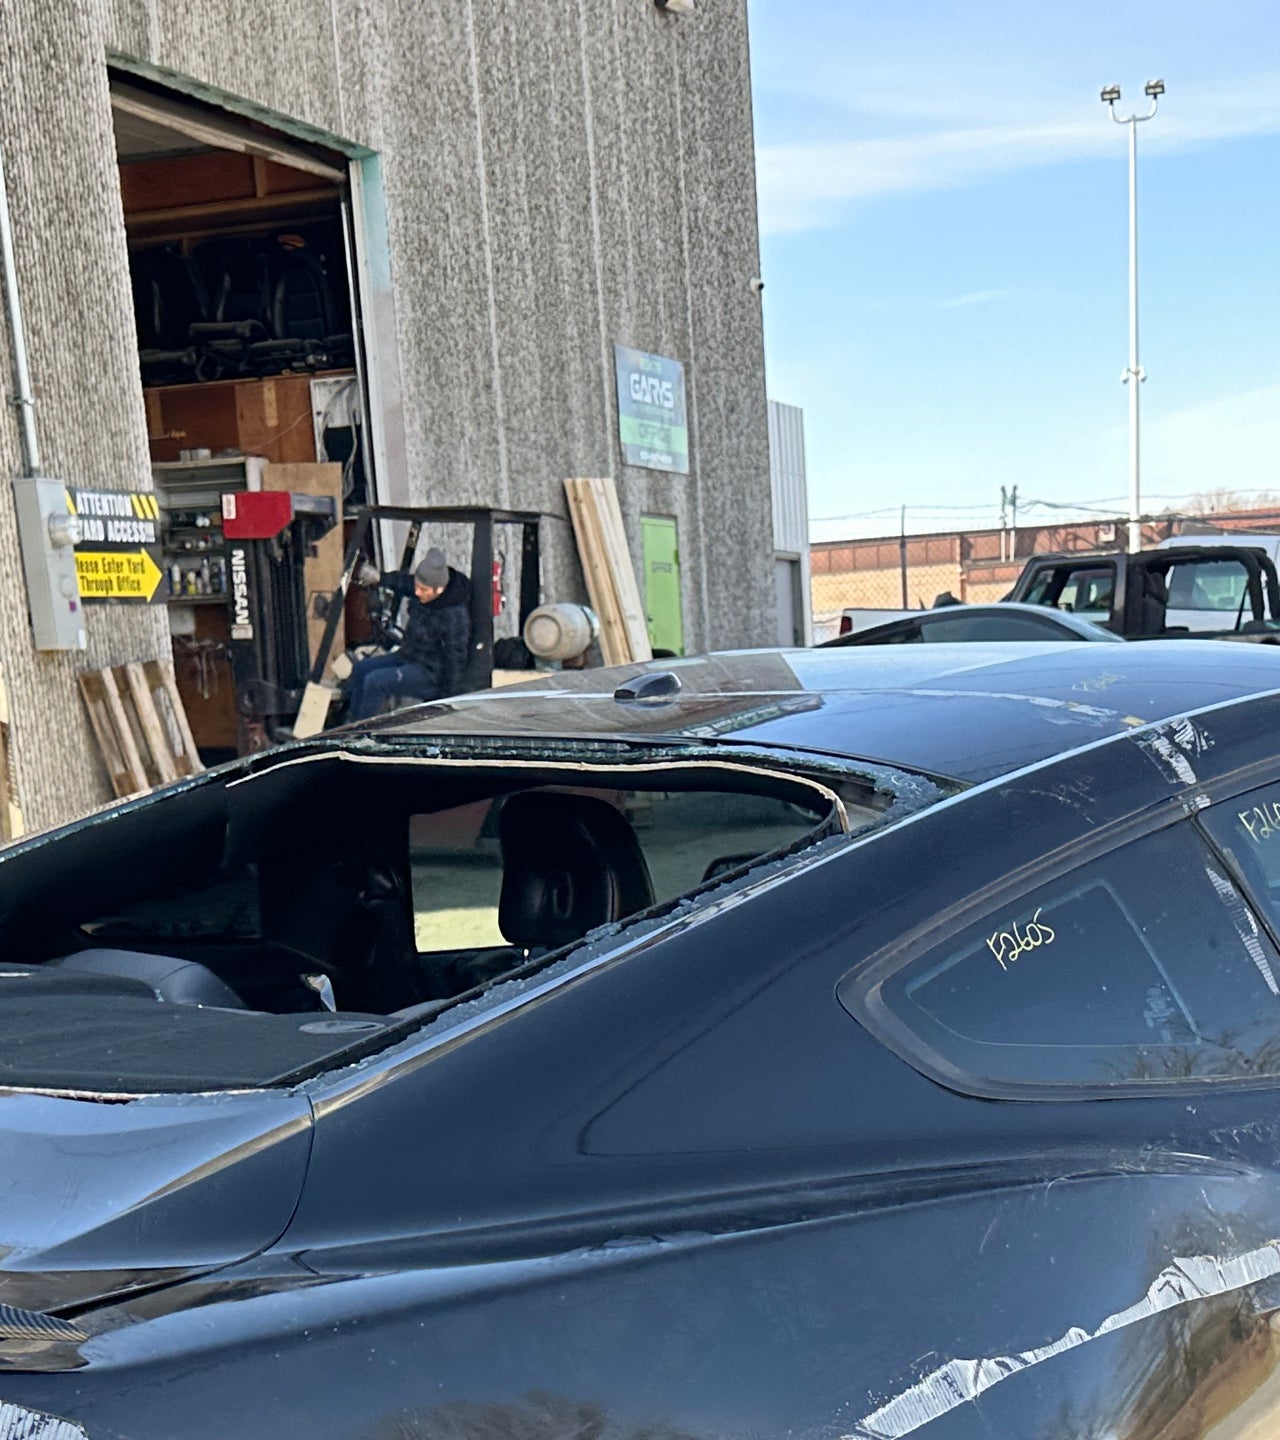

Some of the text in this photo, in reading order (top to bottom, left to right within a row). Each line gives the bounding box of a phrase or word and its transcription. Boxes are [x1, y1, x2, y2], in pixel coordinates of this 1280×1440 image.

[76, 491, 133, 517] ATTENTION
[80, 519, 156, 543] ARD ACCESS!!!
[76, 557, 146, 575] lease Enter Yard
[80, 575, 141, 595] Through Office
[231, 549, 250, 625] NISSAN
[986, 907, 1056, 971] F2605
